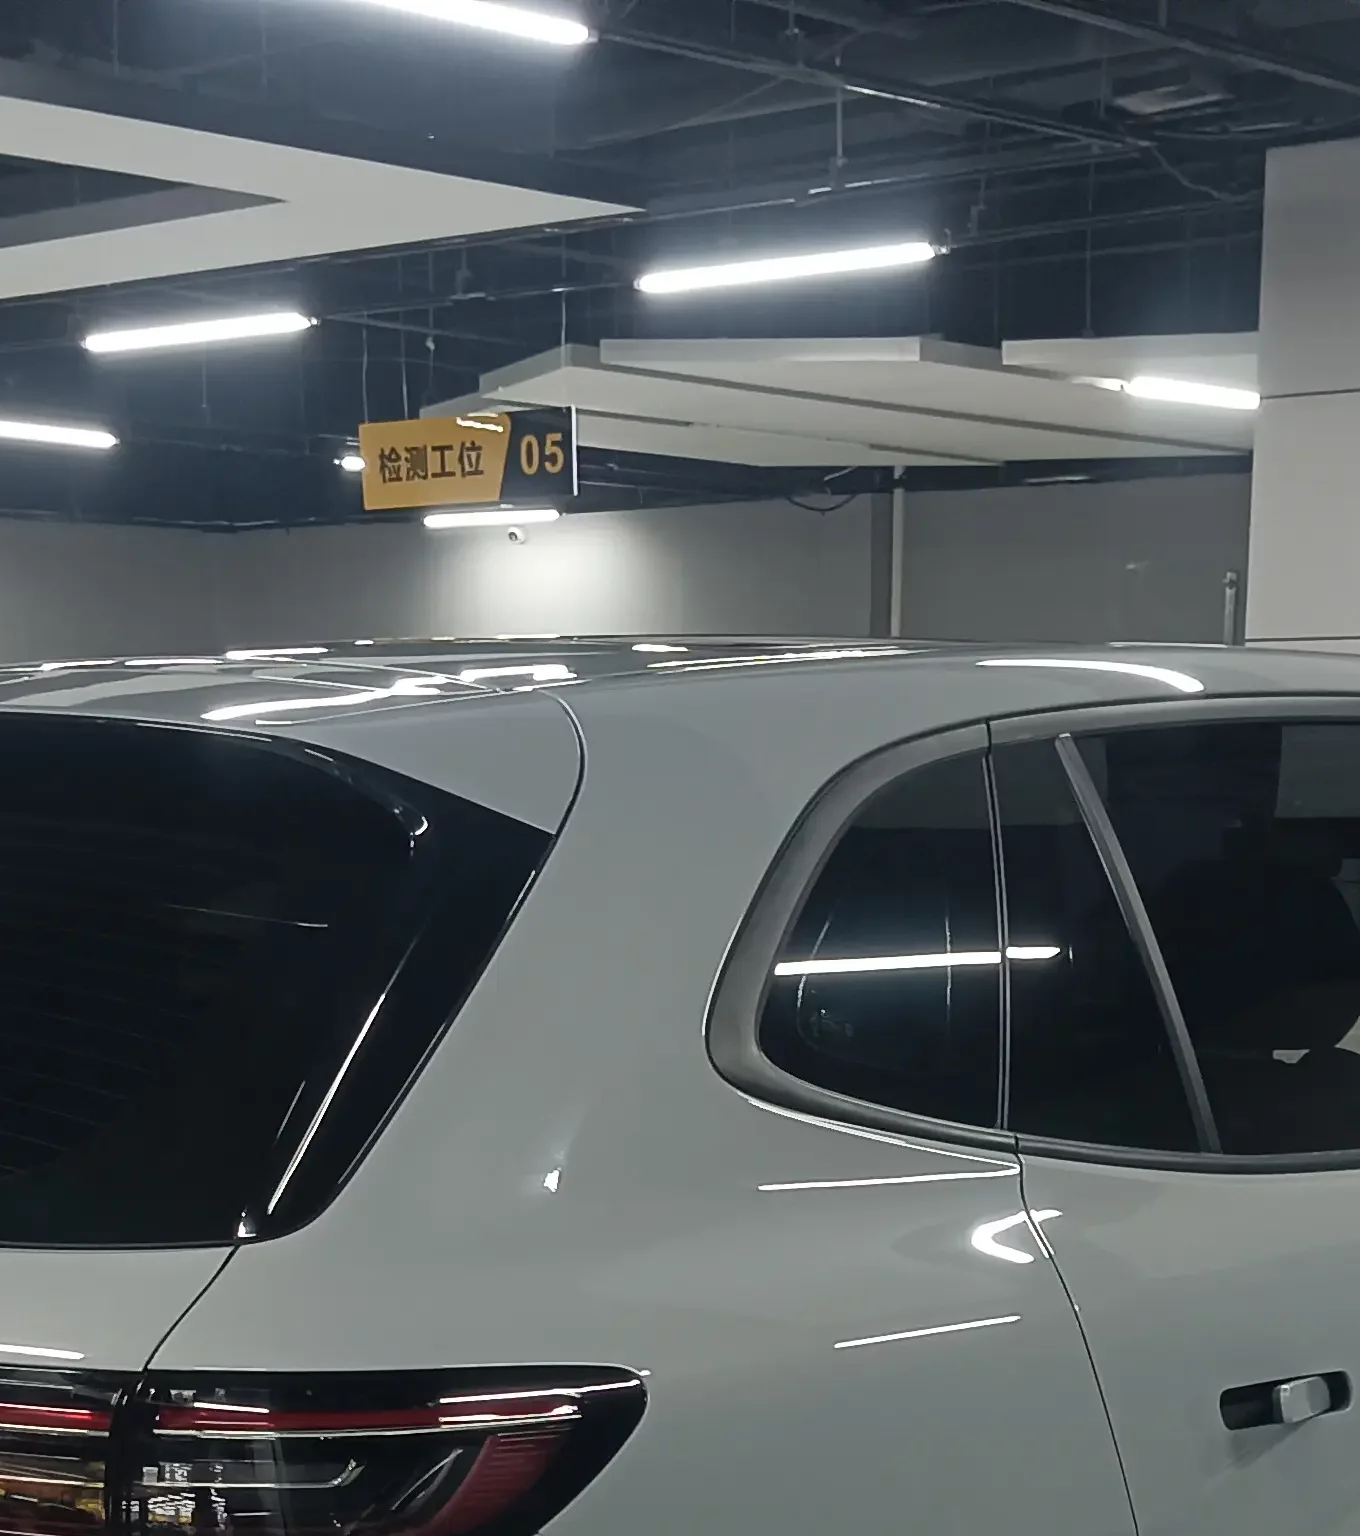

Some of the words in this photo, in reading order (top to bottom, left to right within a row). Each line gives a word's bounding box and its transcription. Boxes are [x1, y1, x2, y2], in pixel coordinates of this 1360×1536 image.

[378, 441, 484, 484] 检测工位
[520, 434, 564, 475] 05
